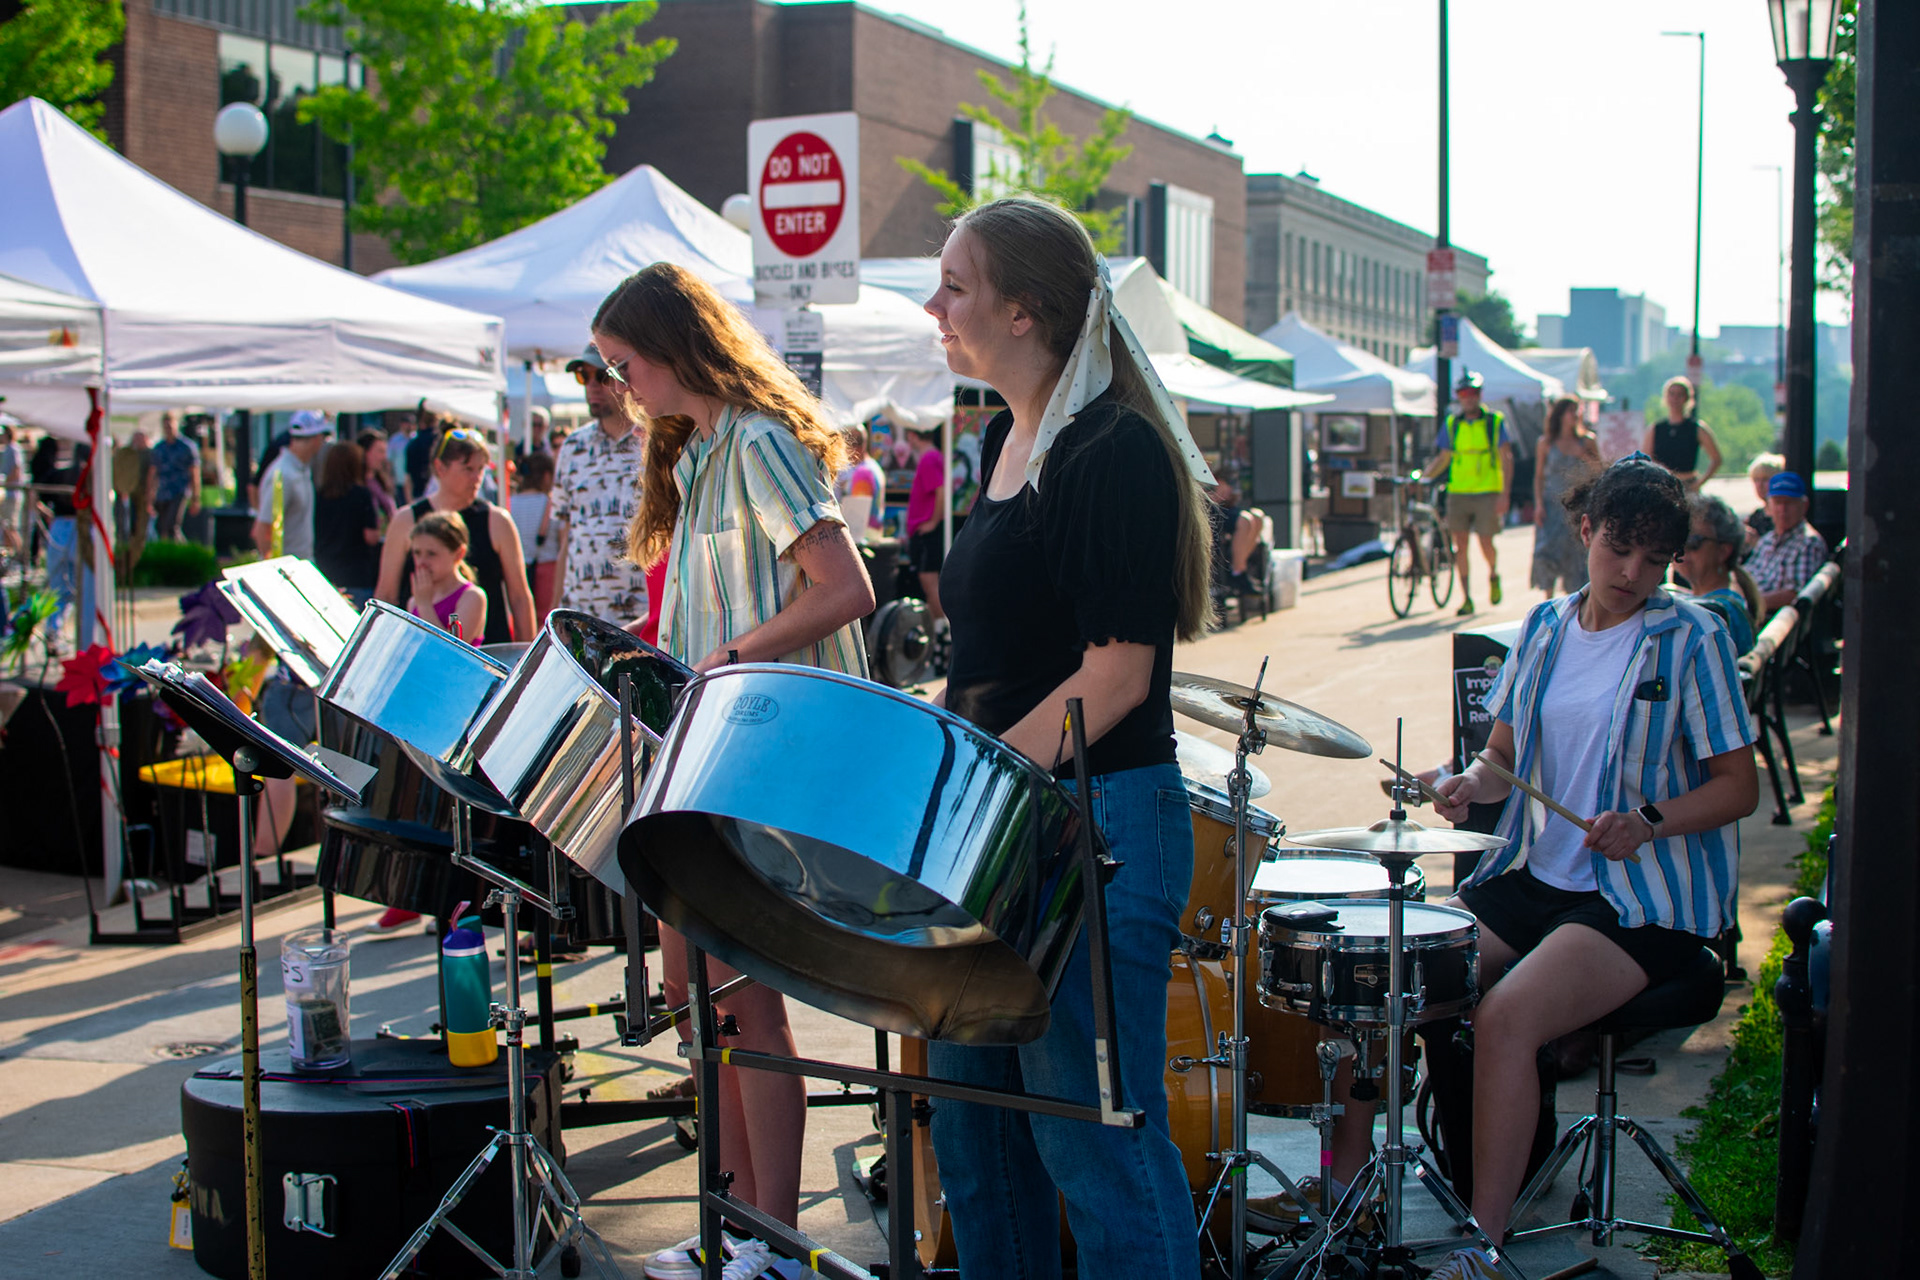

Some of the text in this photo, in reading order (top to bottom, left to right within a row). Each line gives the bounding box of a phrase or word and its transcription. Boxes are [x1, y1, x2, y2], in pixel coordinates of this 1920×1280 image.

[769, 152, 832, 179] DO NOT
[775, 212, 826, 235] ENTER
[755, 263, 793, 281] BICYCLES
[798, 262, 817, 279] AND
[790, 284, 812, 301] ONLY
[733, 696, 771, 713] COYLE
